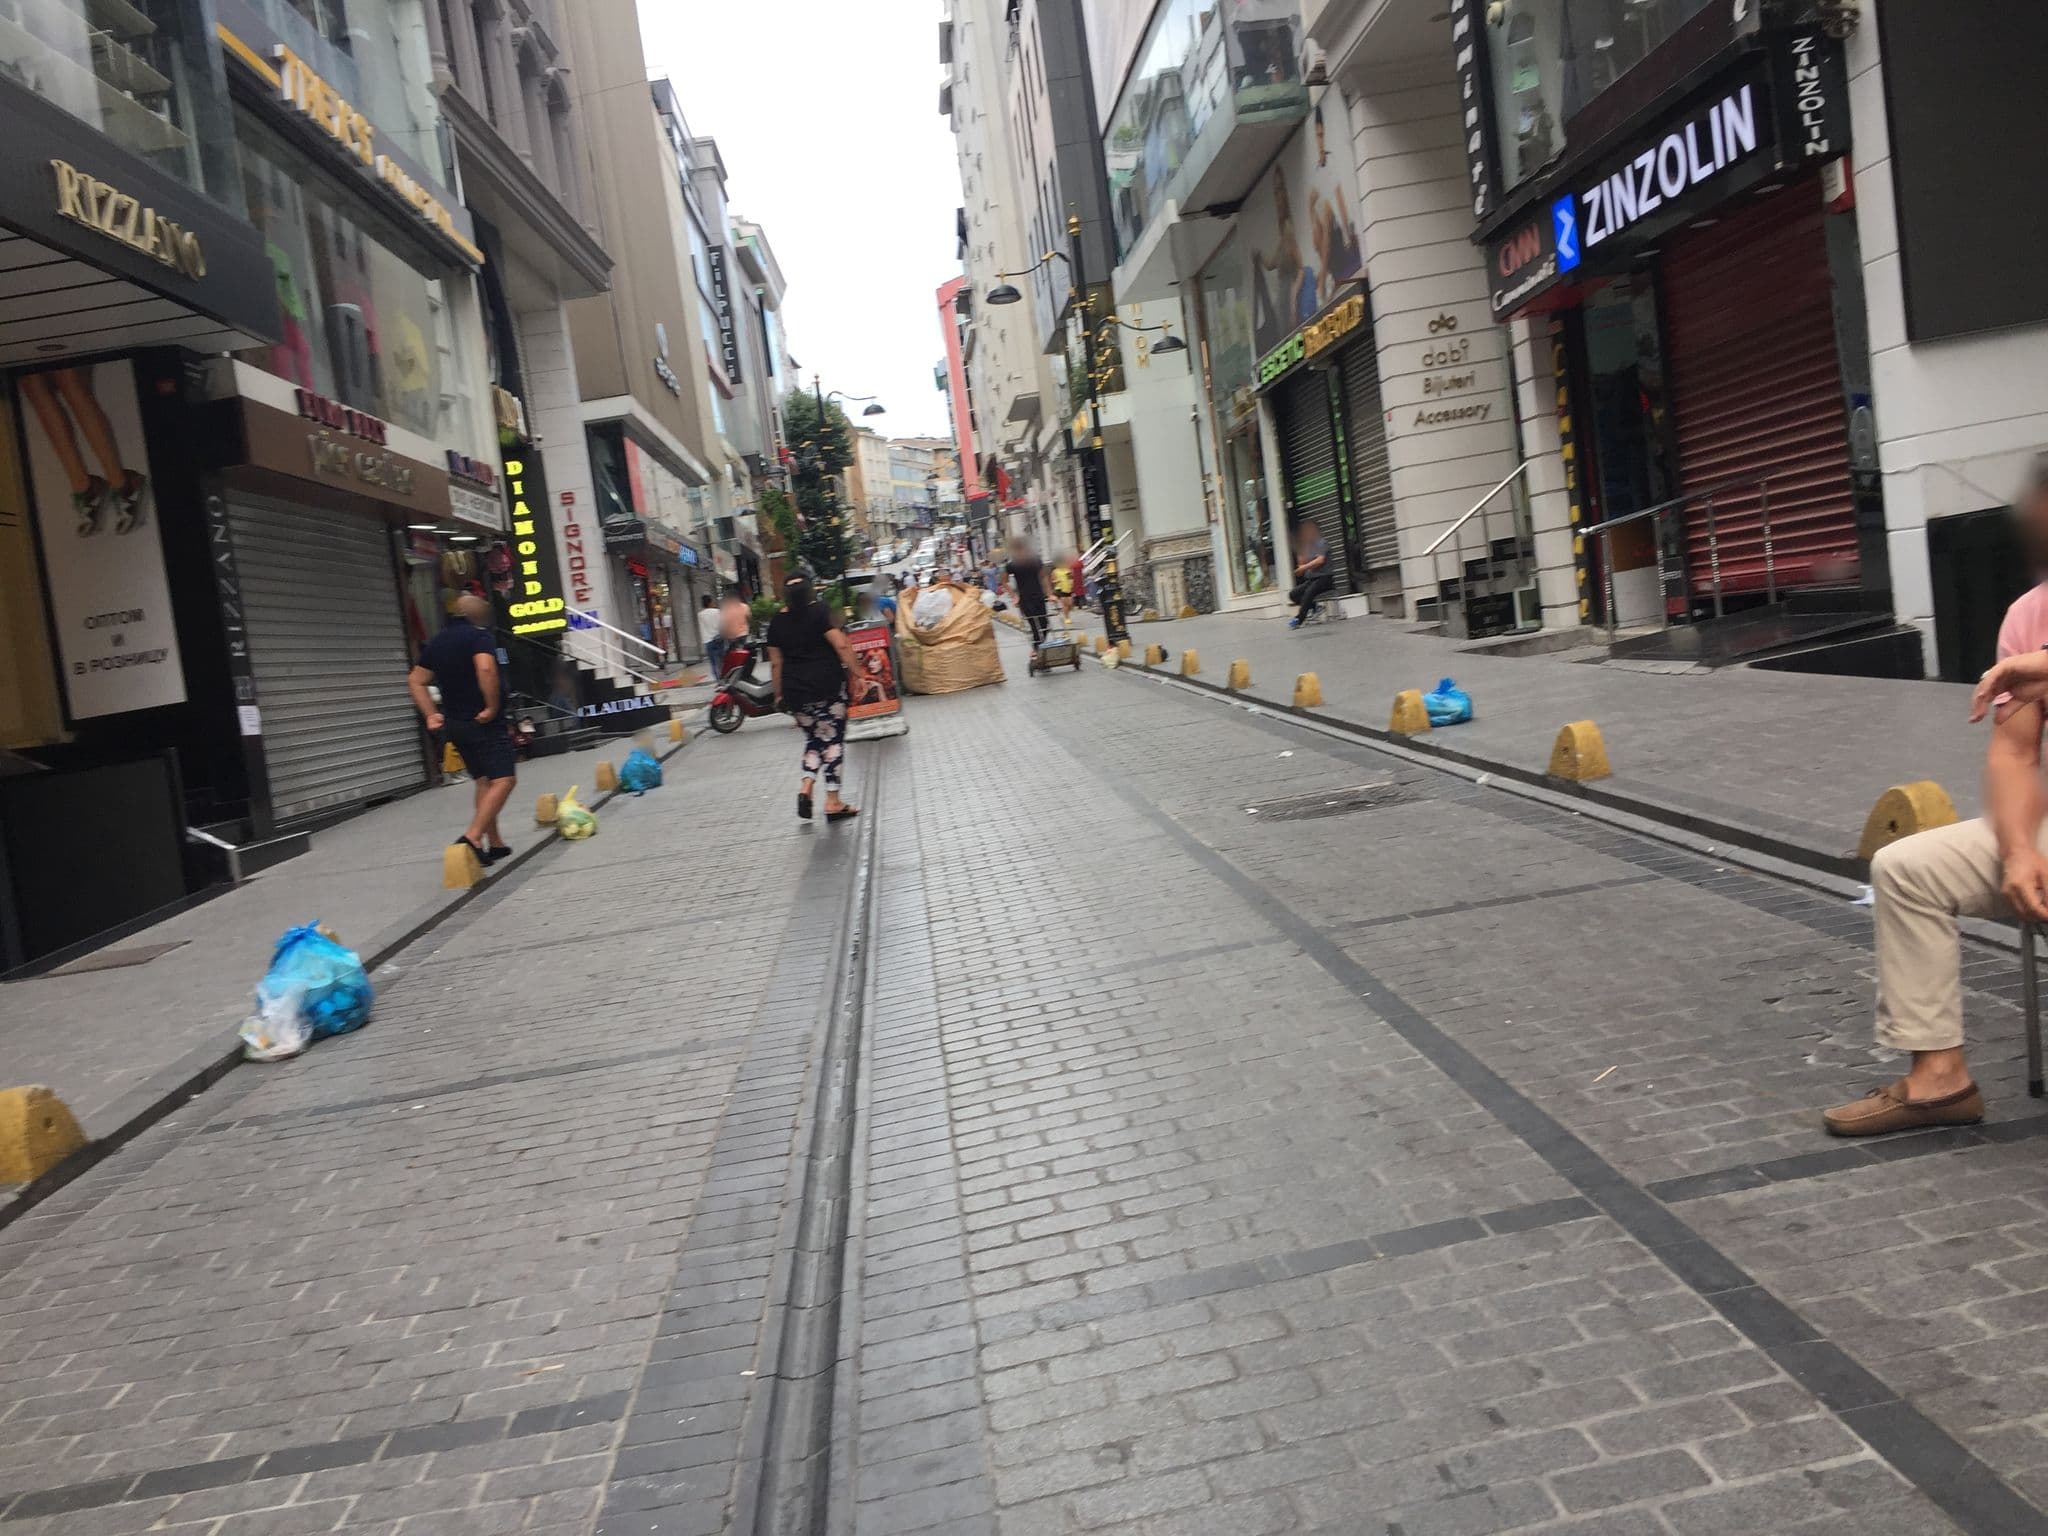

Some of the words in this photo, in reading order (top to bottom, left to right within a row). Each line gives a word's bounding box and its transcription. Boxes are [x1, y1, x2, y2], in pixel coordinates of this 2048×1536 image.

[1793, 36, 1829, 156] ZINZOLIN
[1582, 84, 1756, 247] ZINZOLIN
[1414, 403, 1491, 426] Accessory
[505, 460, 543, 596] DIAMOND
[509, 598, 564, 617] GOLD
[577, 696, 654, 717] CLAUDIA
